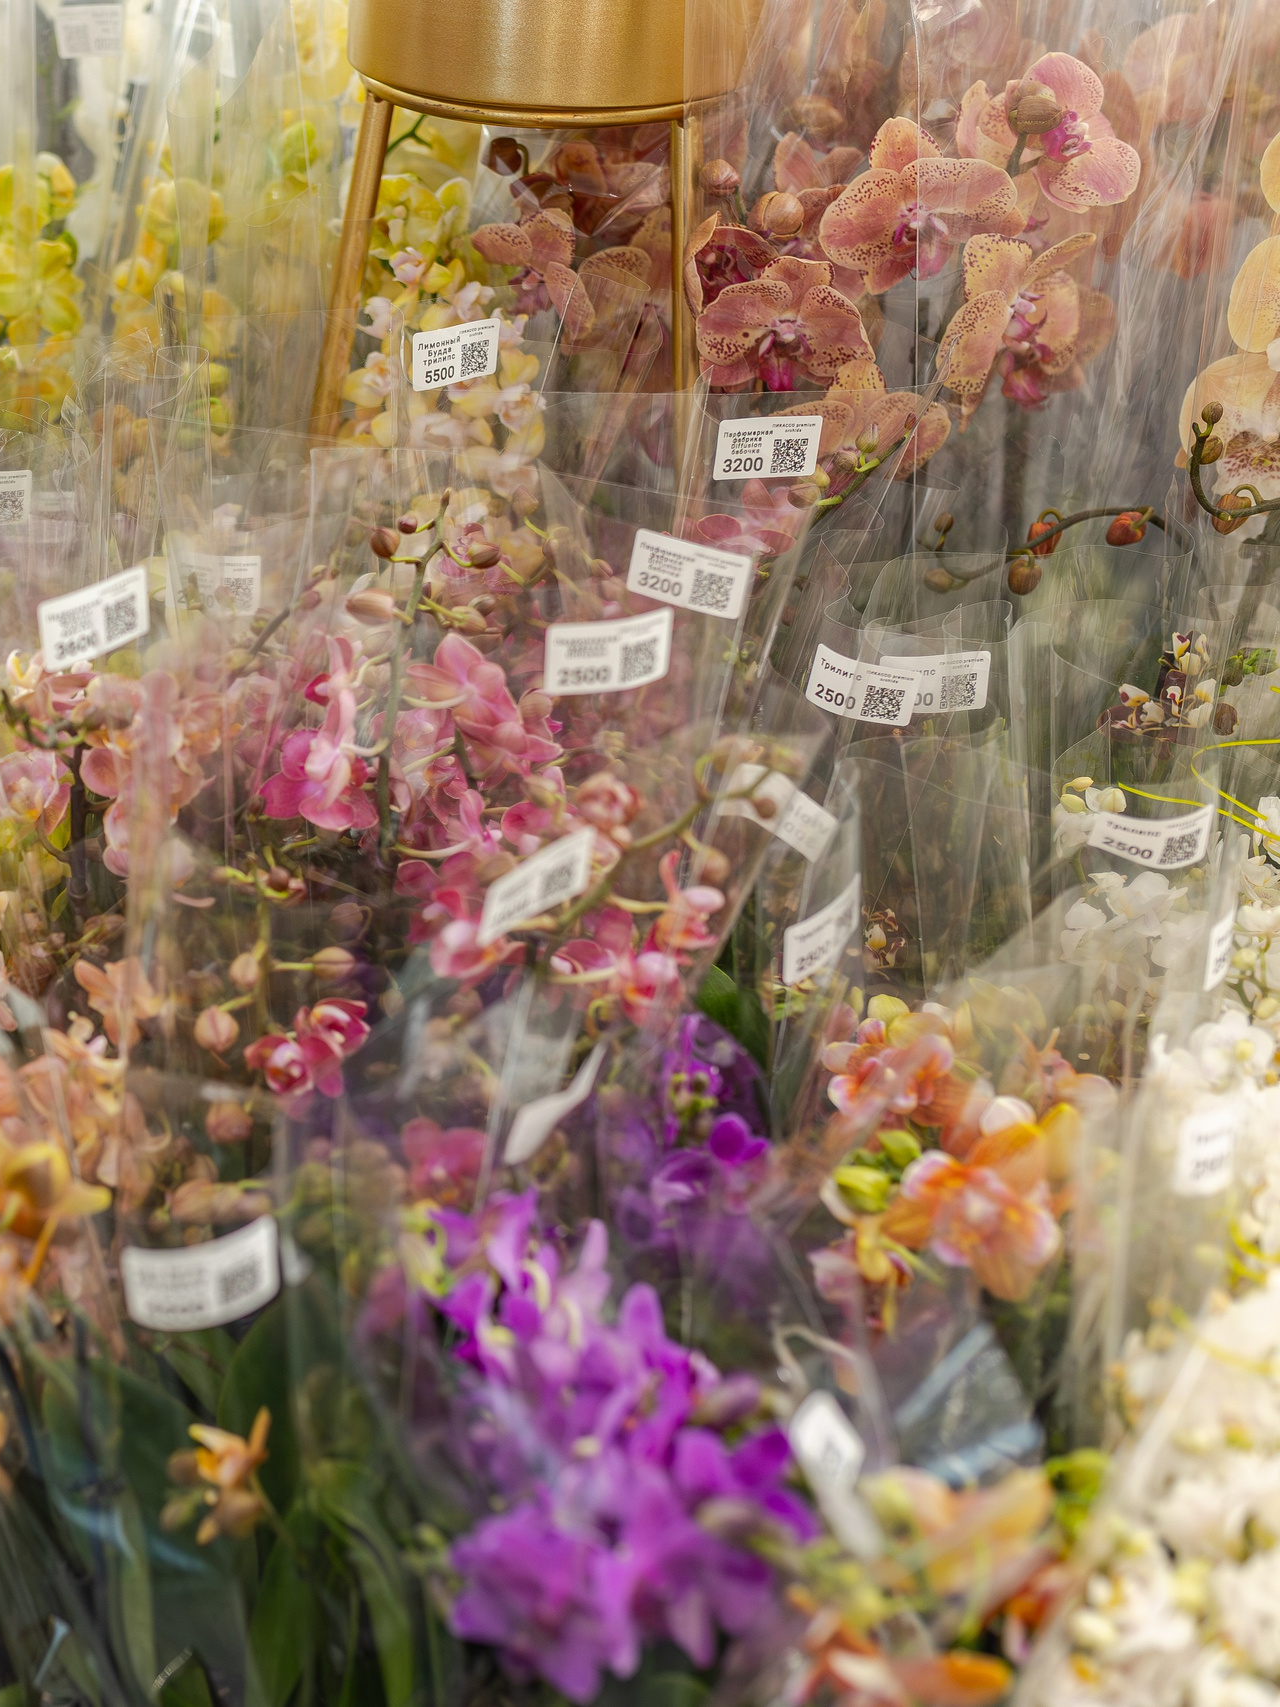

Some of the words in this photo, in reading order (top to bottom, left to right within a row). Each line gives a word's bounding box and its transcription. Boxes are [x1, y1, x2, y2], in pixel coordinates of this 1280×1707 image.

[417, 335, 461, 351] Лимонный
[423, 353, 456, 367] трилипс
[427, 347, 452, 358] Будда
[424, 365, 455, 384] 5500
[723, 429, 774, 438] Парфюмерная
[732, 436, 762, 444] фабрика
[730, 442, 762, 450] Diffusion
[722, 456, 764, 473] 3200
[638, 571, 683, 597] 3200
[556, 665, 612, 687] 2500
[820, 657, 862, 682] Трилипс
[814, 683, 856, 710] 2500
[1102, 836, 1153, 860] 2500
